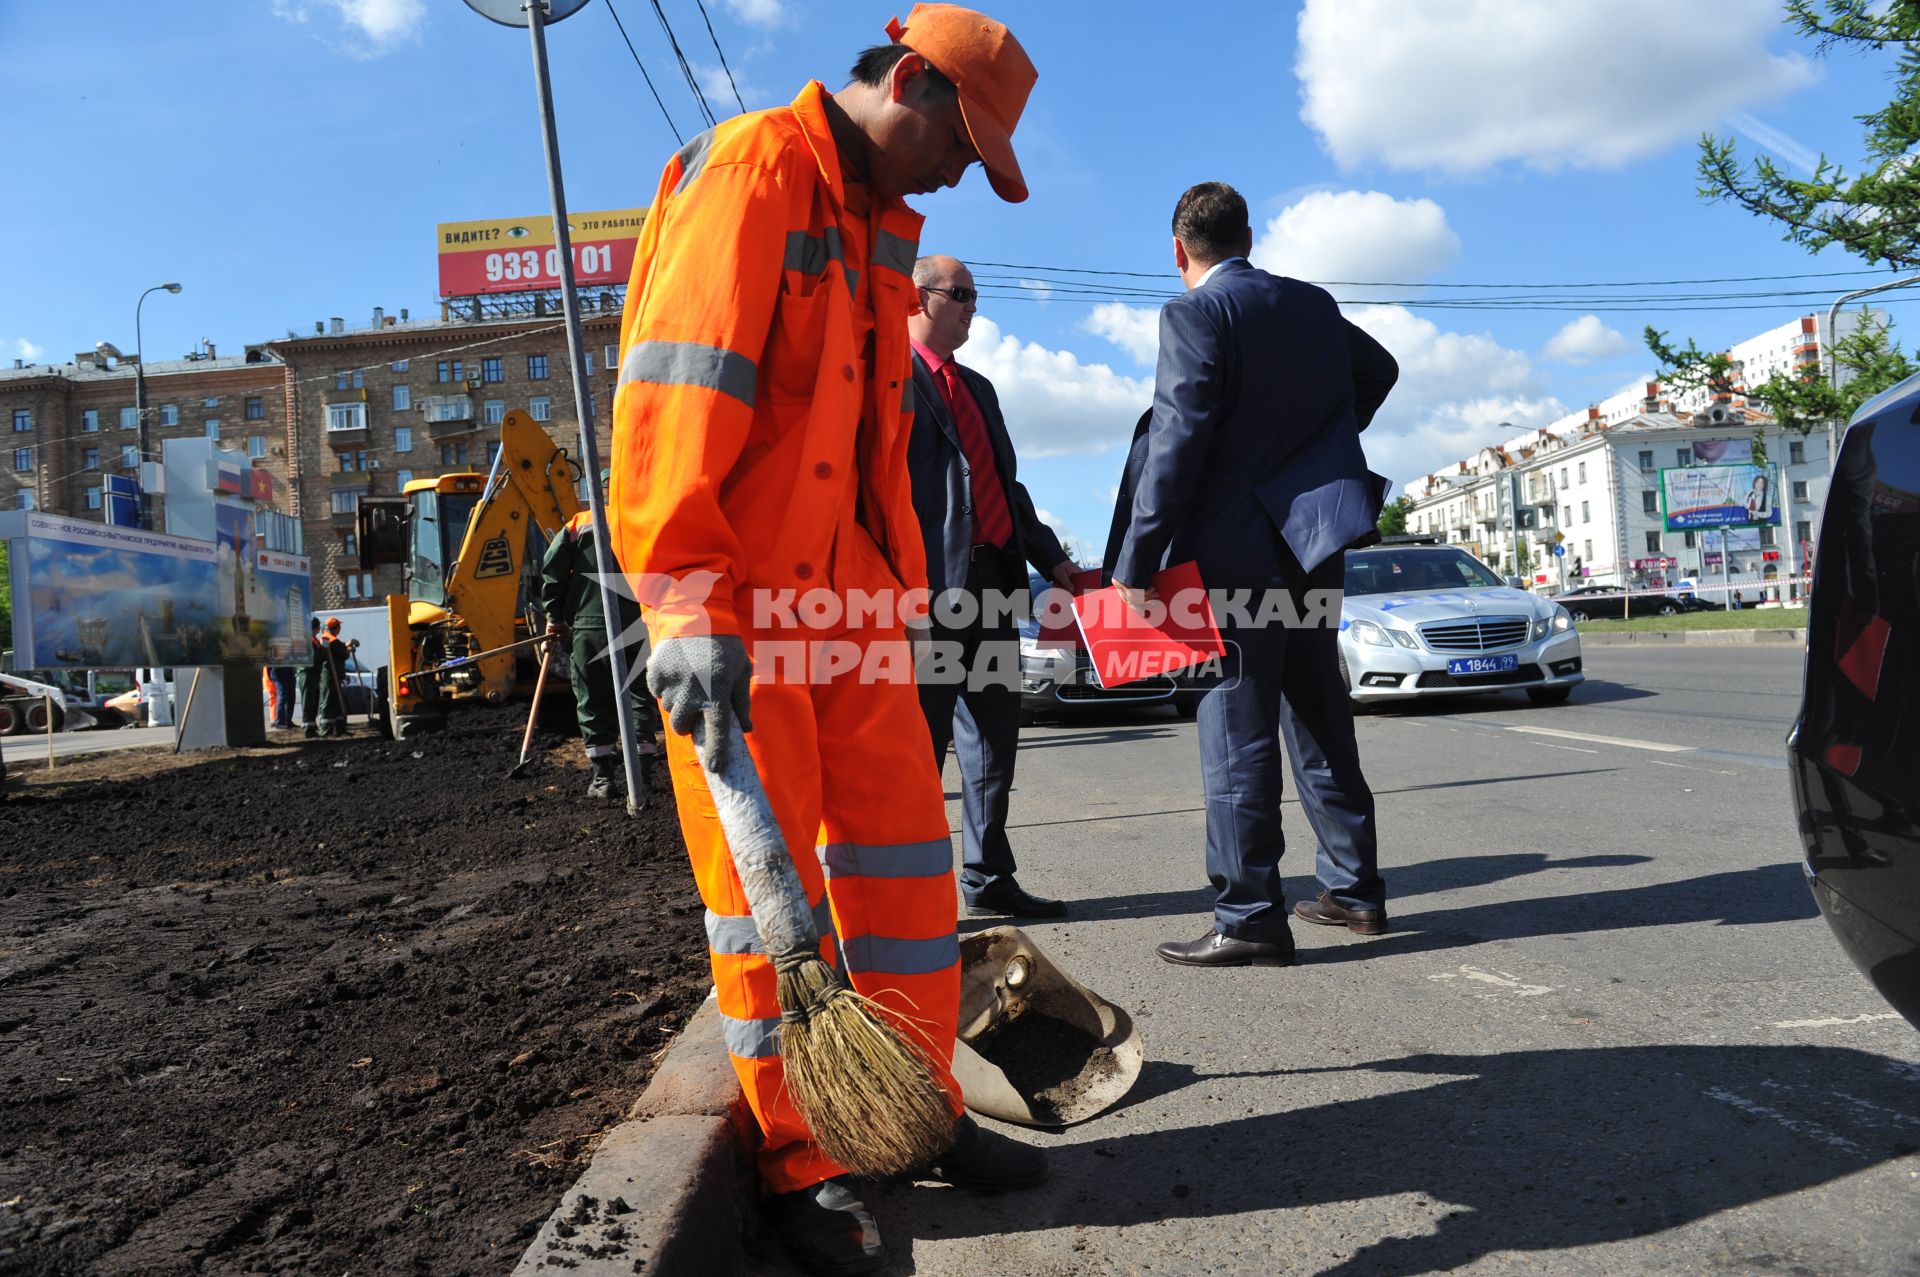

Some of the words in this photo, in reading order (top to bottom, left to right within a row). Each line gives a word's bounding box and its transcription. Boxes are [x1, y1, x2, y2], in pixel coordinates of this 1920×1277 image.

[582, 221, 599, 230] ЭТО
[445, 228, 500, 244] ВИДИТЕ?
[485, 250, 539, 282] 933
[545, 247, 576, 277] 0
[581, 244, 612, 273] 01
[478, 540, 512, 576] JCB
[1467, 658, 1496, 671] 1844
[1502, 656, 1514, 665] 99
